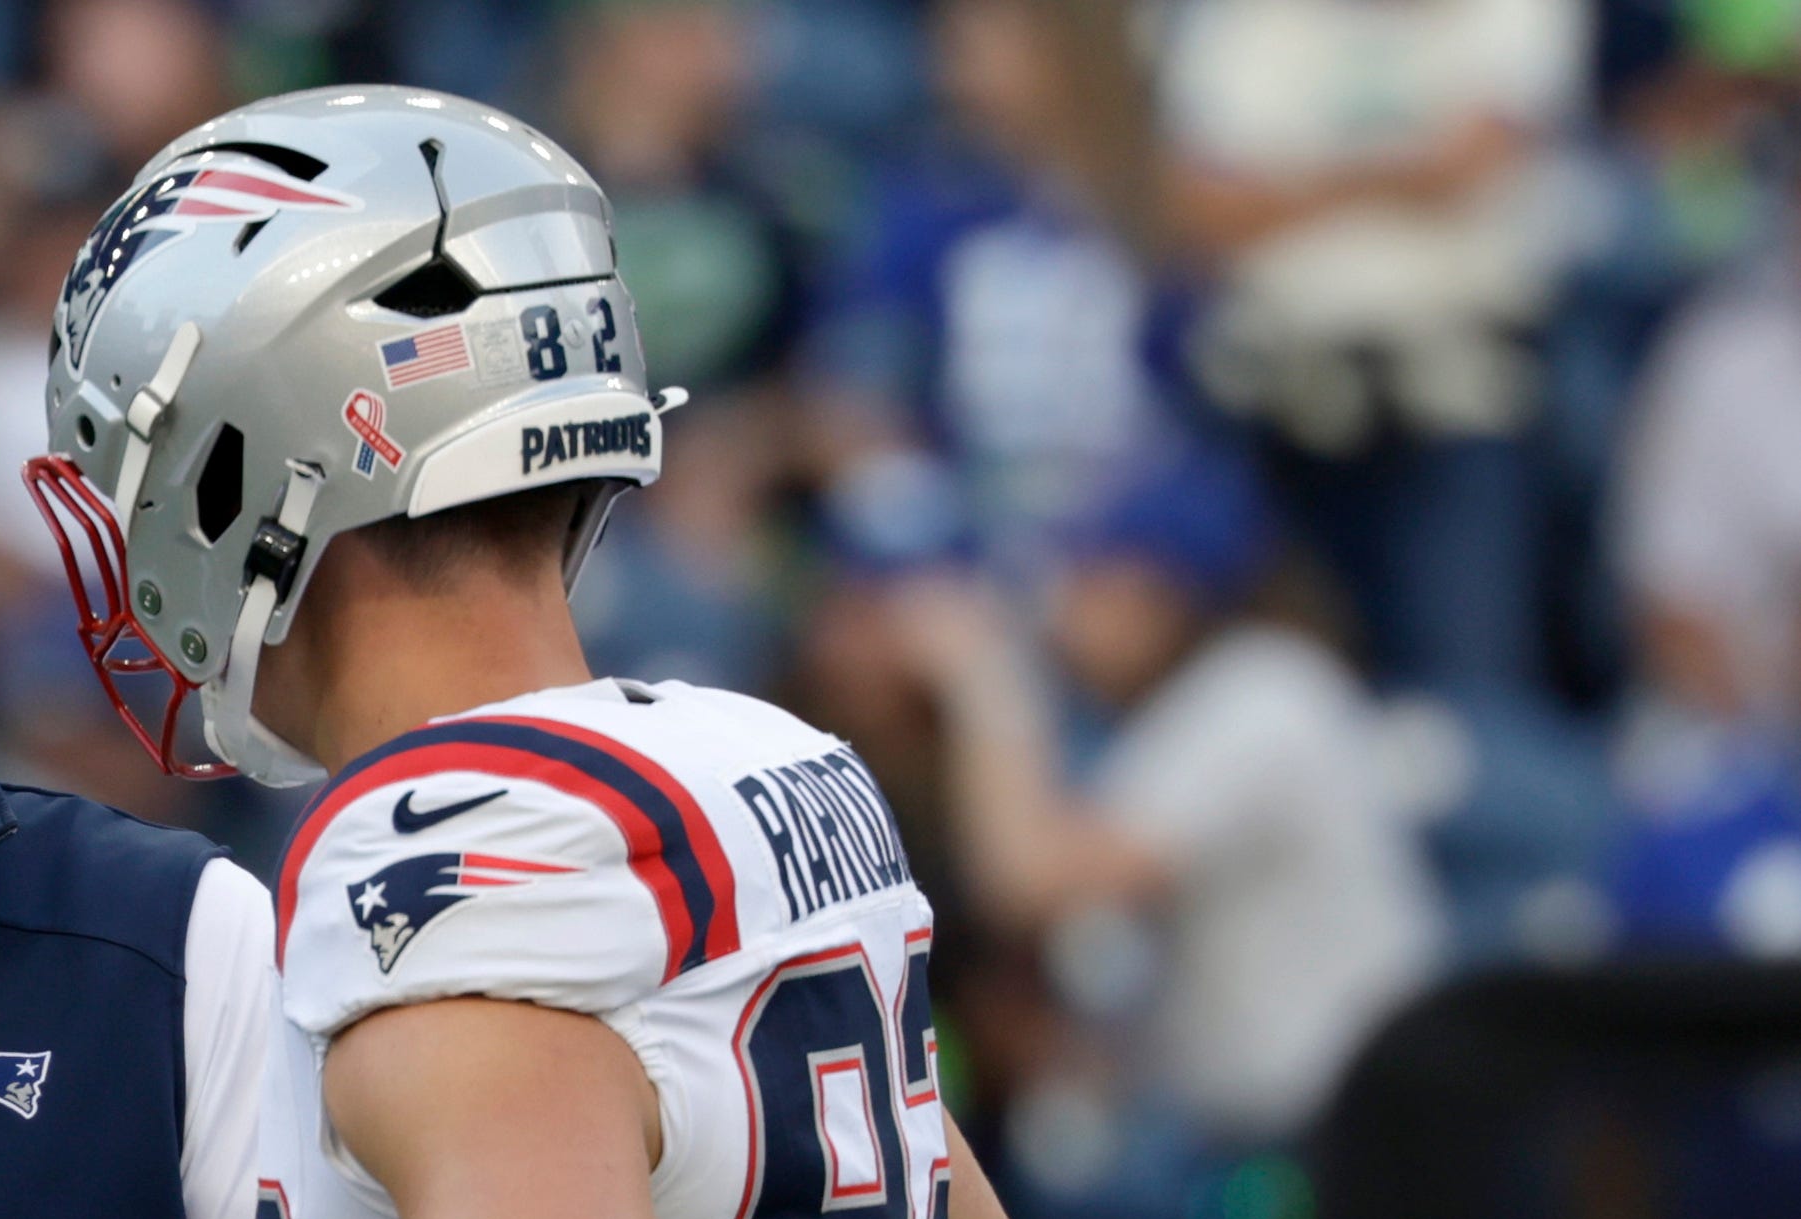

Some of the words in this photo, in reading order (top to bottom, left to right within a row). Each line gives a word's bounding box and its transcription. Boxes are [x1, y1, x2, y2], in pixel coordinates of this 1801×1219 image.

[519, 297, 622, 381] 82
[521, 411, 652, 475] PATRIOTS
[733, 747, 911, 923] RARIDO
